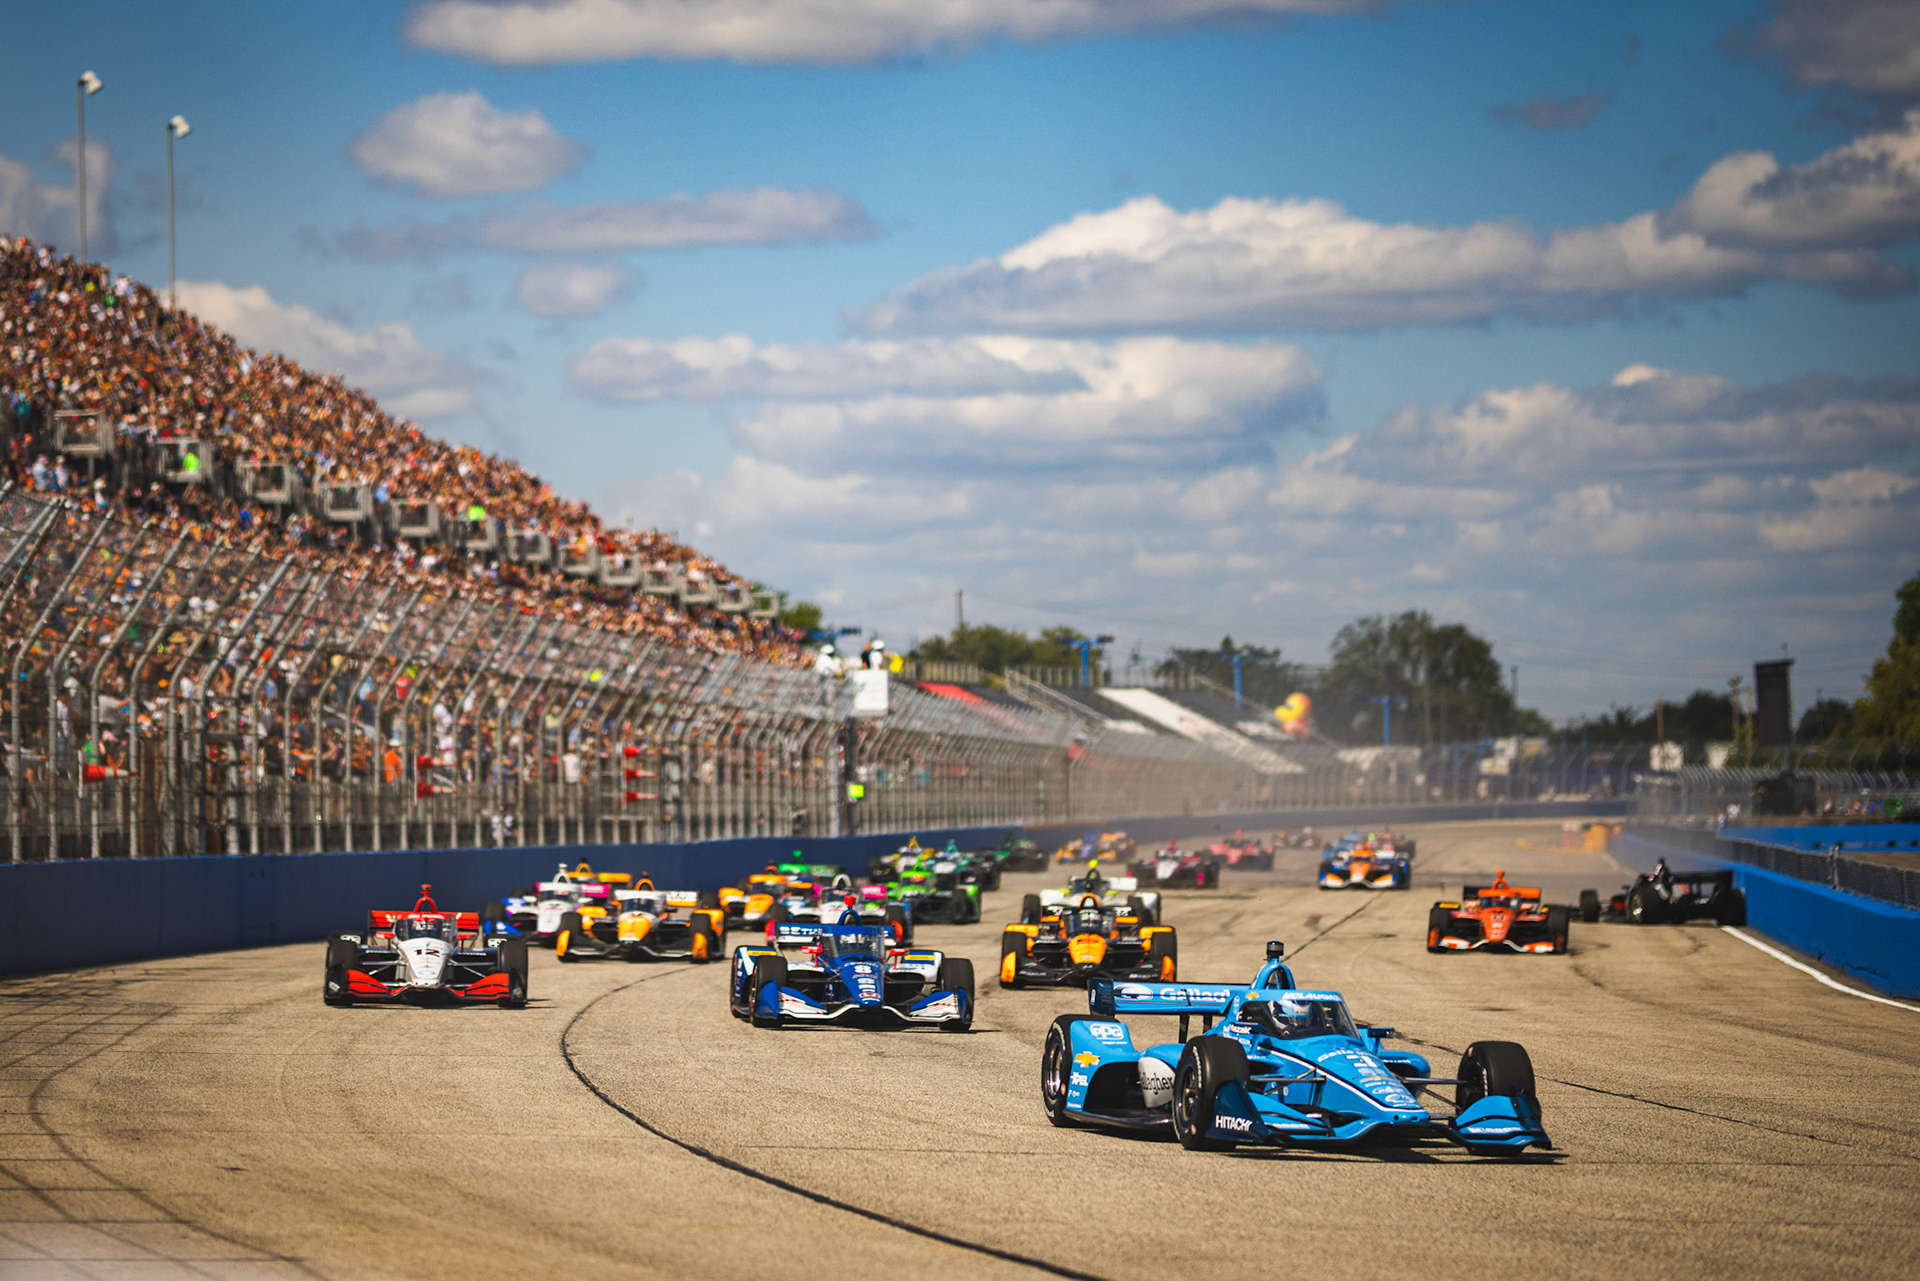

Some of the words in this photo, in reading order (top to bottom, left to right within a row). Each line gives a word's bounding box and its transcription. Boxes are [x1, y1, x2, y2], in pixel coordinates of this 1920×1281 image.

[414, 949, 440, 958] 12
[854, 965, 872, 973] 8
[1092, 1026, 1121, 1039] PPG
[1070, 1071, 1088, 1086] XPEL
